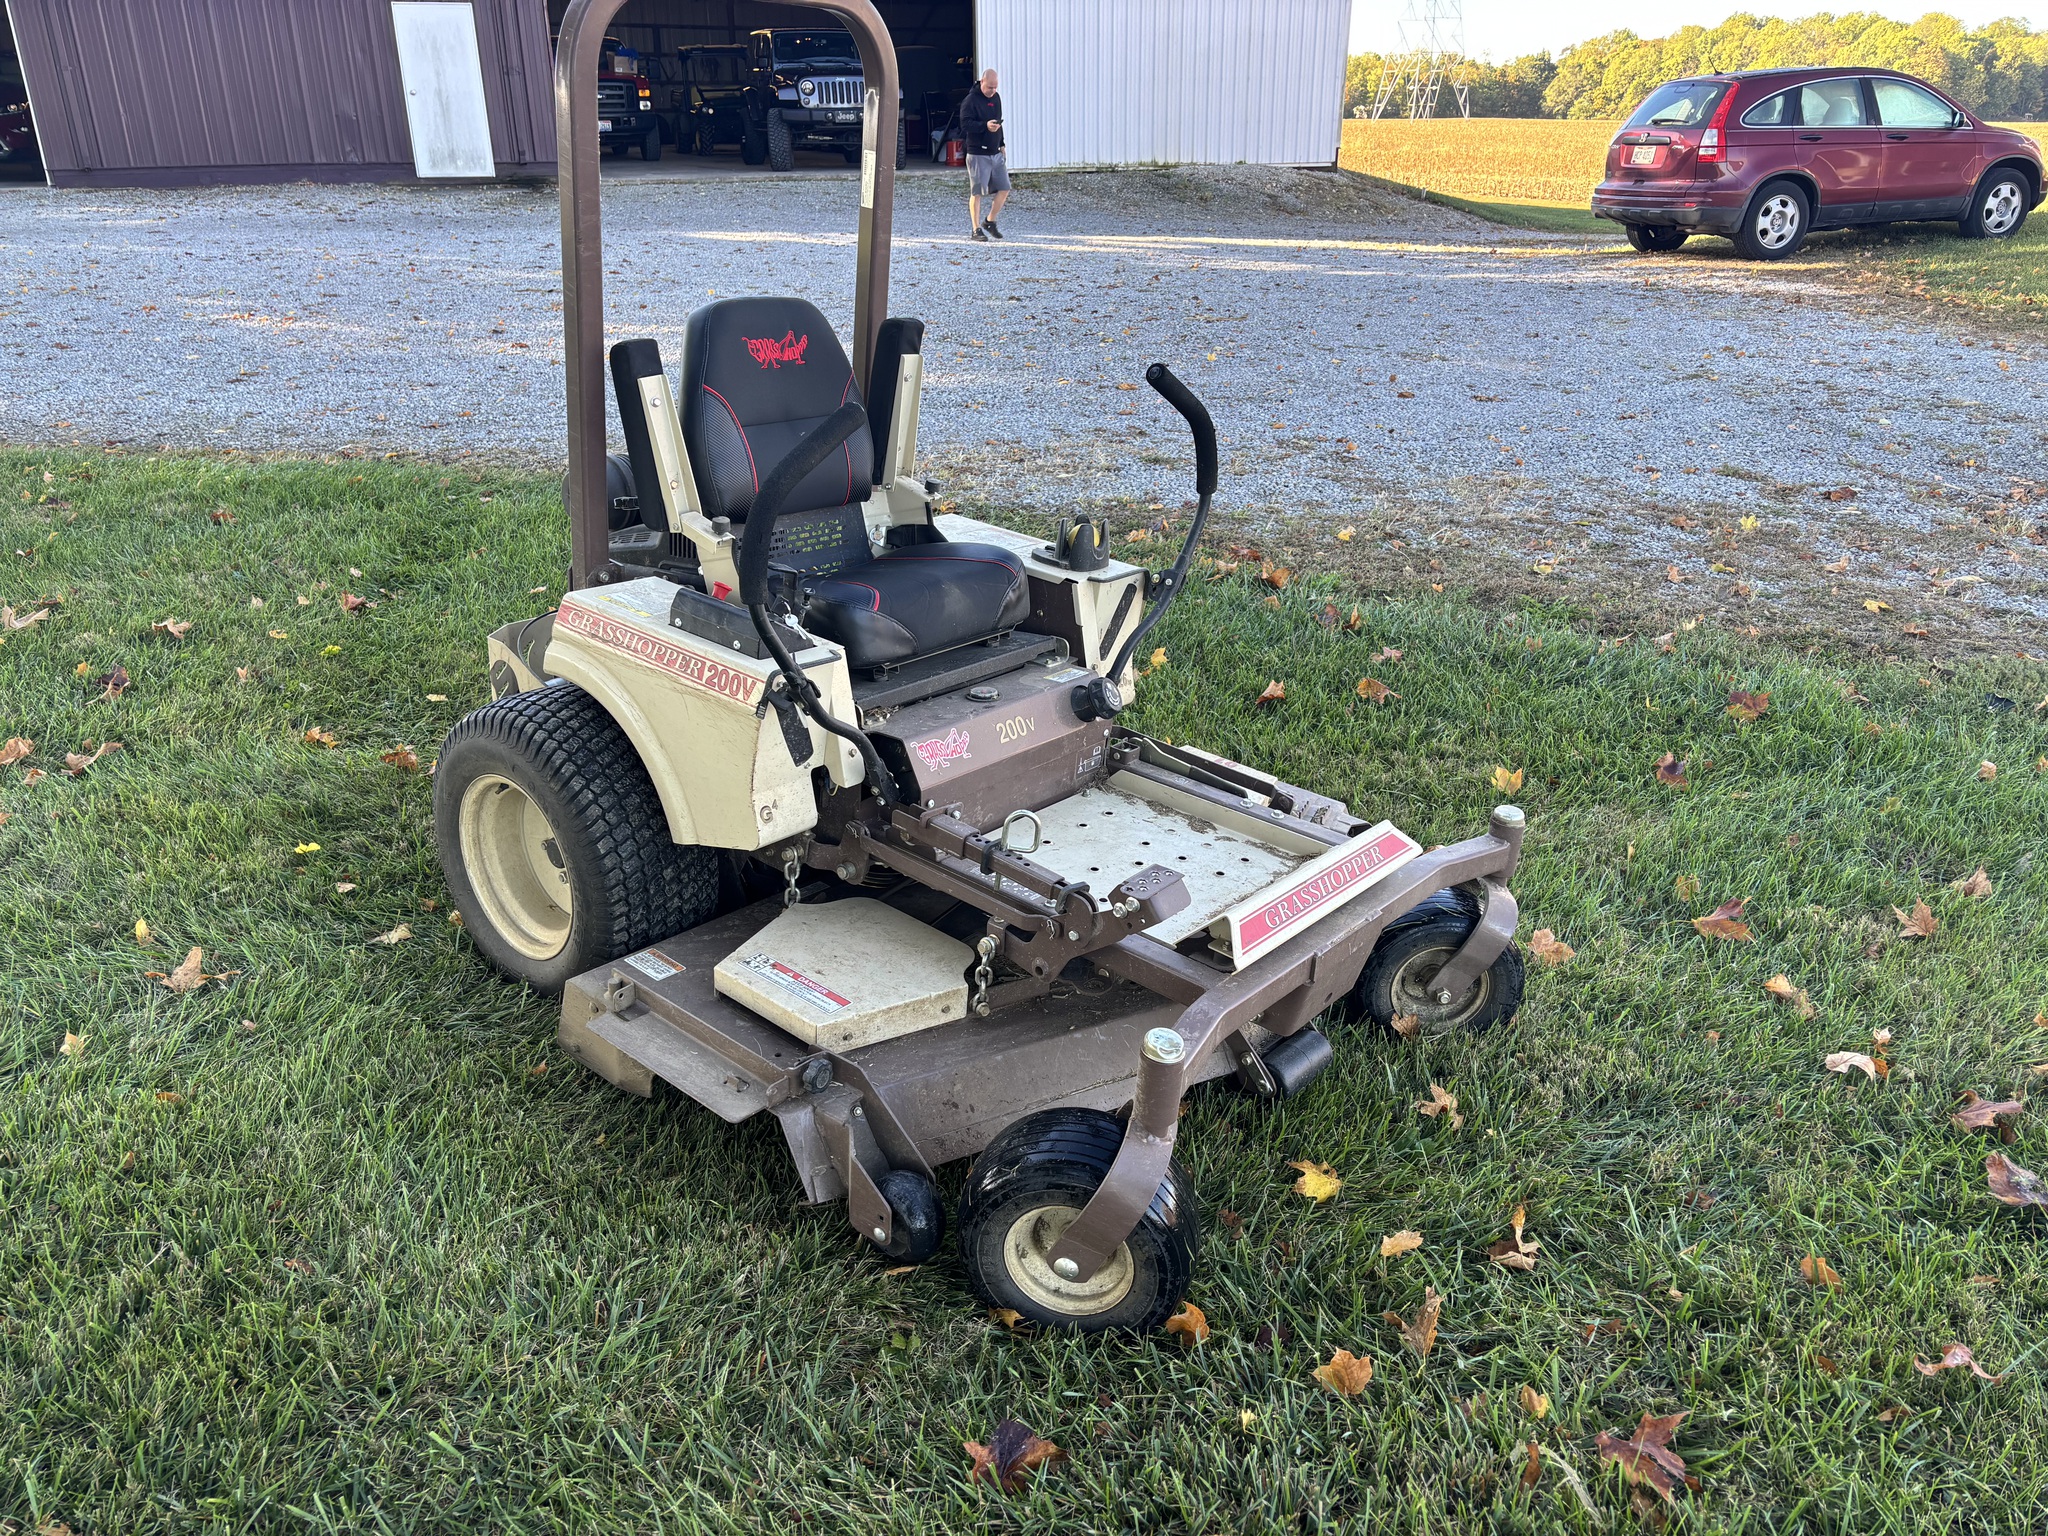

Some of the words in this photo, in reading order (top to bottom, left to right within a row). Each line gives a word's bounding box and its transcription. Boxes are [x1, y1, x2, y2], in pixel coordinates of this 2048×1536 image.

[837, 110, 855, 121] Jeep
[568, 610, 703, 679] GRASSHOPPER
[704, 664, 757, 701] 200V
[1265, 845, 1385, 929] GRASSHOPPER
[797, 976, 829, 995] DANGER
